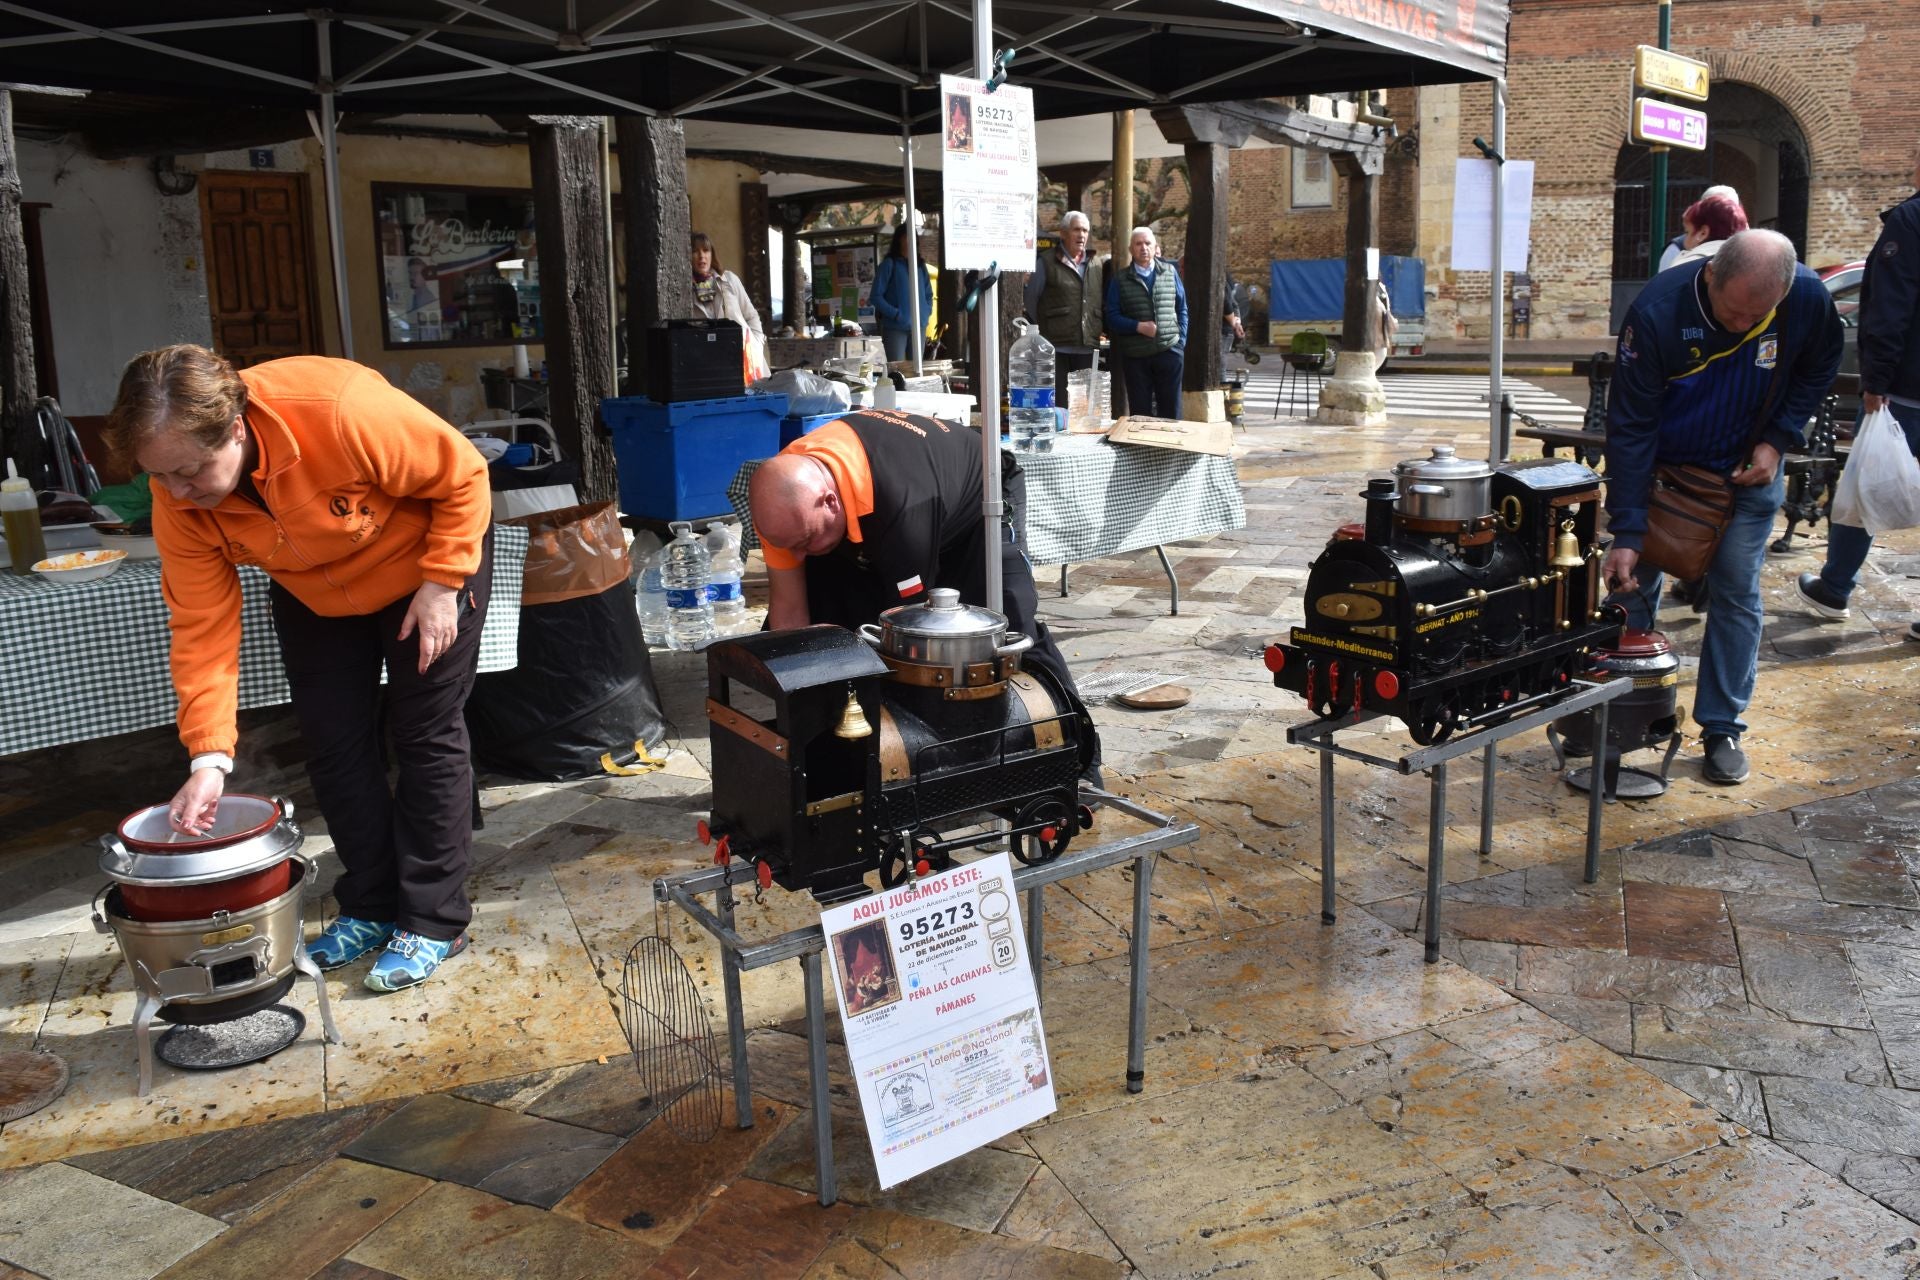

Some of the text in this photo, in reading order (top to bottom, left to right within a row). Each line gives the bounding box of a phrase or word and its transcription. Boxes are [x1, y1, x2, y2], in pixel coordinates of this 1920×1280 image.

[976, 105, 1013, 122] 95273
[257, 151, 267, 166] 5
[1293, 629, 1394, 661] Santander-Mediterraneo
[853, 868, 983, 921] AQUÍ JUGAMOS ESTE:
[900, 902, 974, 941] 95273
[899, 921, 979, 954] LOTERÍA NACIONAL
[915, 934, 967, 957] DE NAVIDAD
[916, 958, 924, 966] de
[925, 948, 954, 963] diciembre
[955, 945, 963, 953] de
[998, 946, 1010, 958] 20
[908, 986, 932, 1001] PEÑA
[933, 980, 948, 993] LAS
[950, 964, 992, 987] CACHAVAS
[935, 993, 977, 1016] PÁMANES
[970, 1028, 1013, 1051] Nacional
[964, 1048, 989, 1063] 95273
